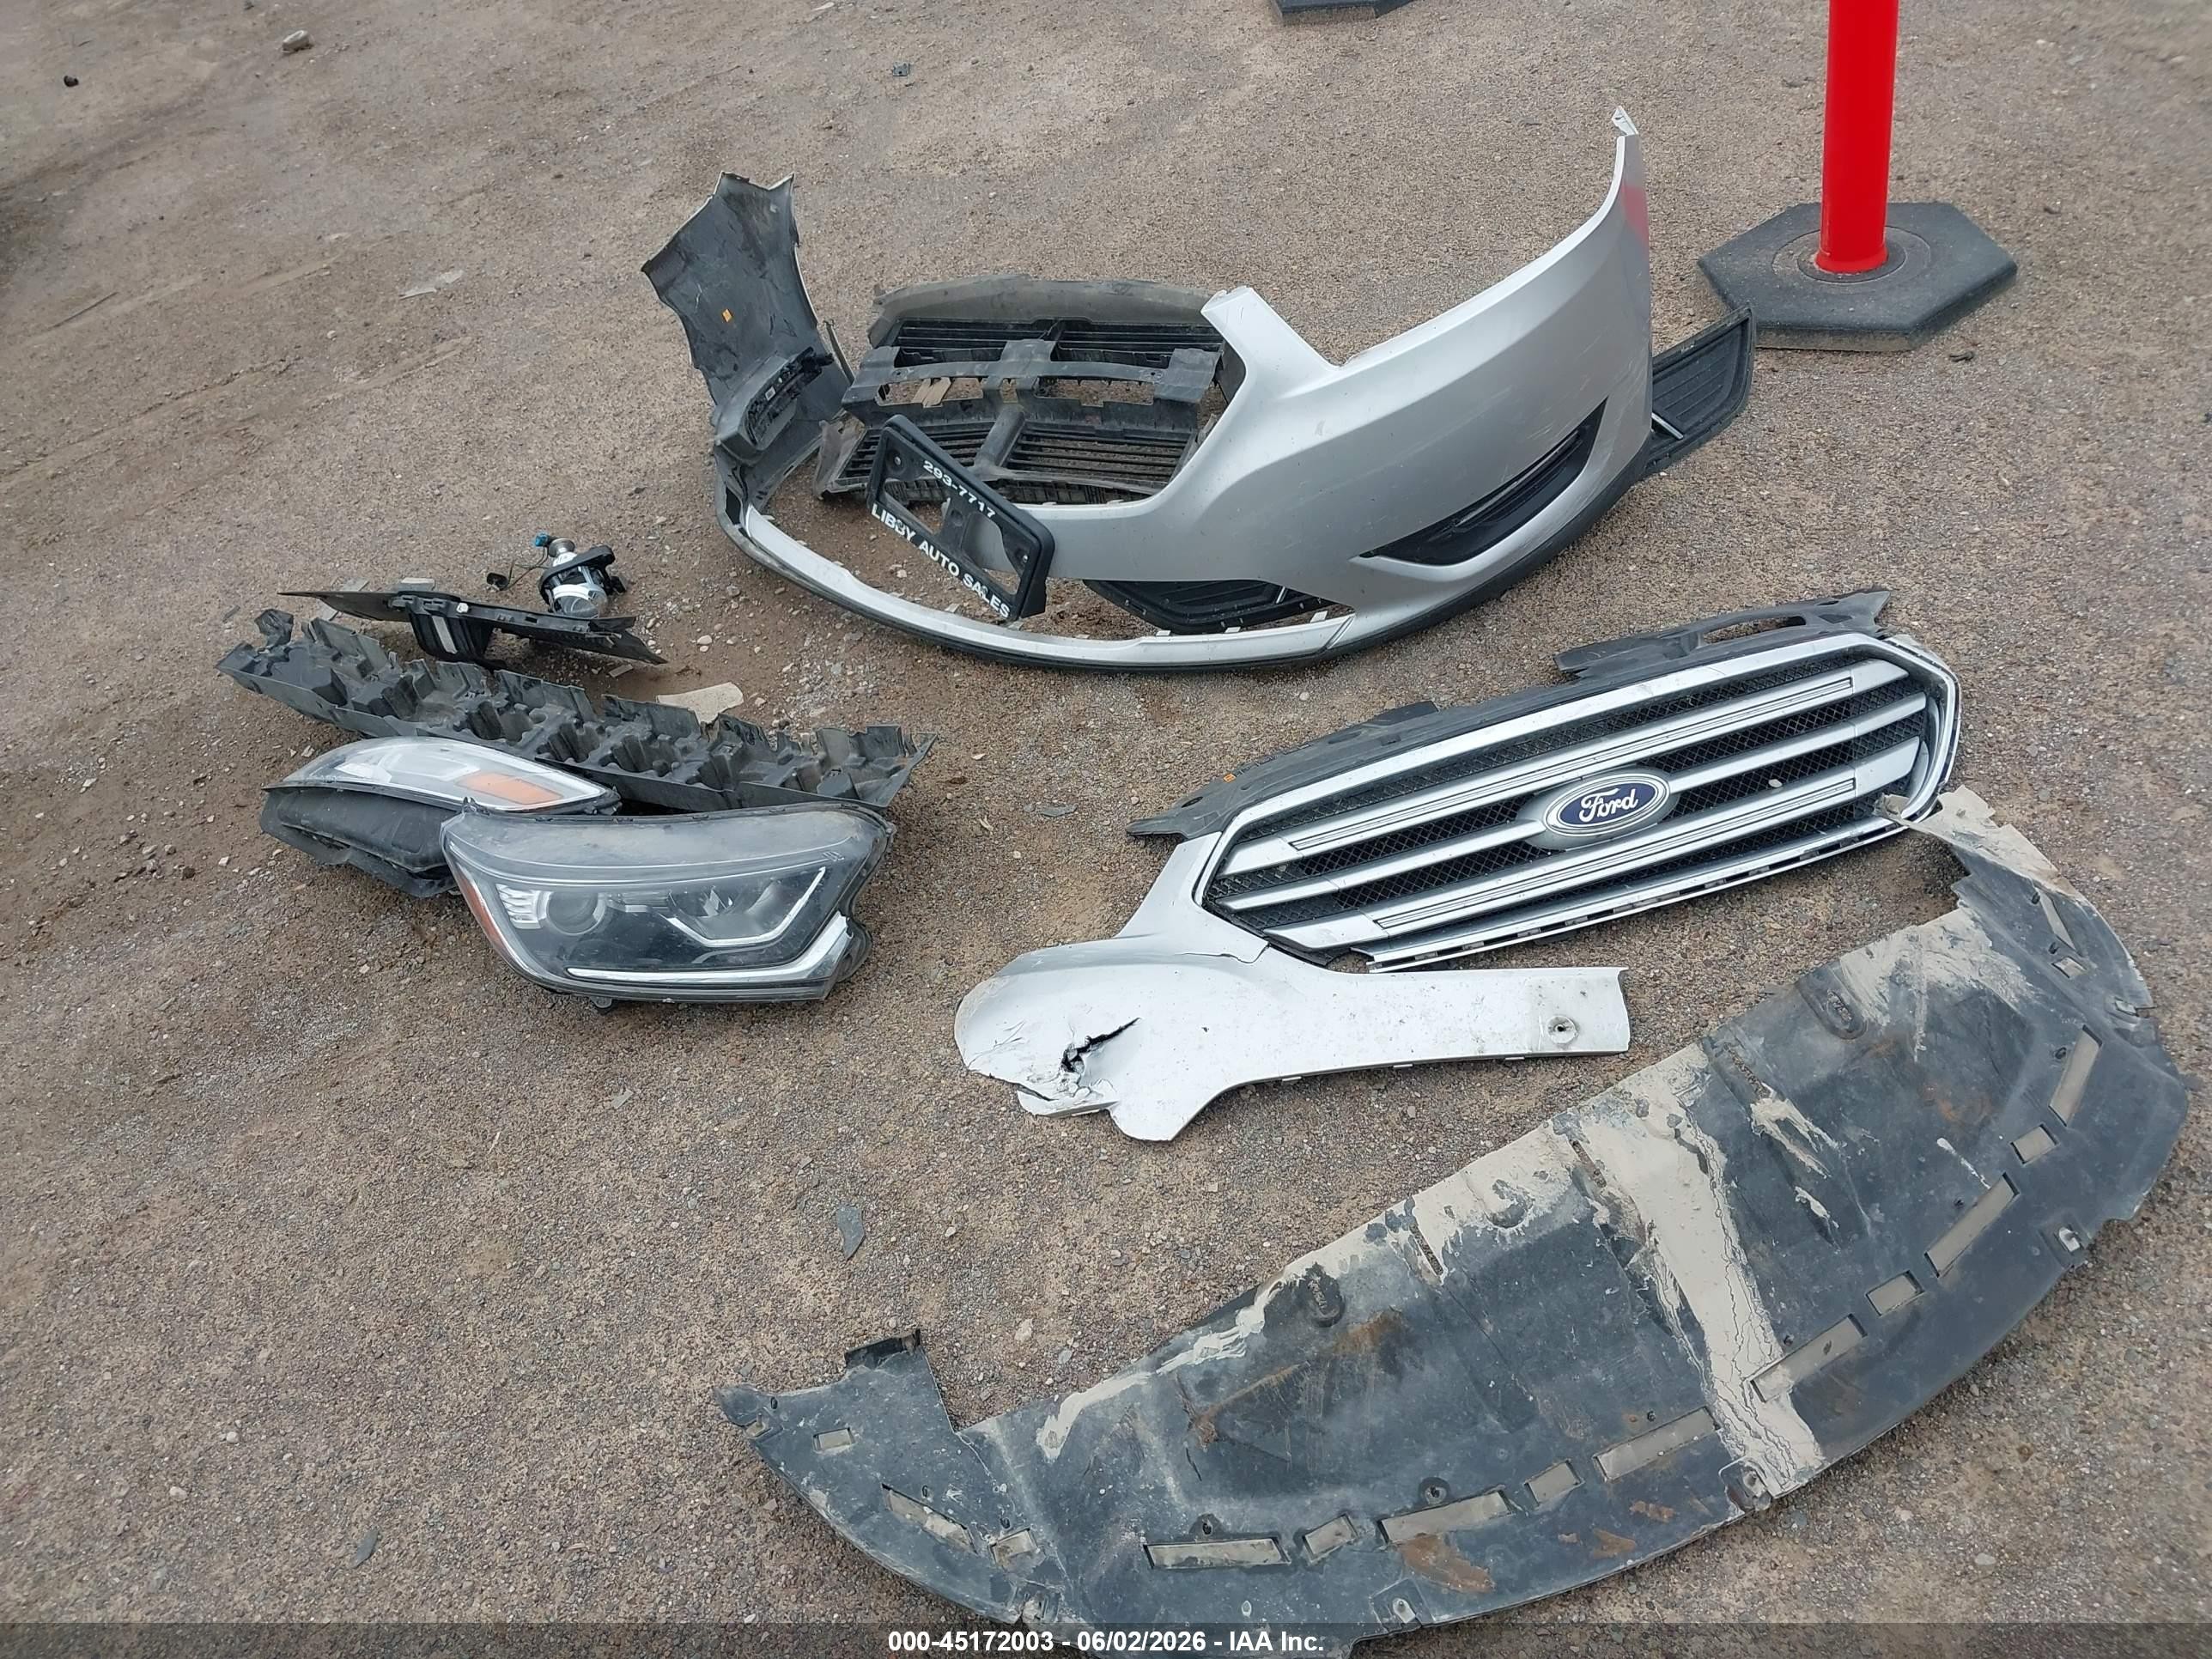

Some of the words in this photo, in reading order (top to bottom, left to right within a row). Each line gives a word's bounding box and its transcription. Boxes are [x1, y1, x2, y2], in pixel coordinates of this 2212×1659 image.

[923, 460, 996, 518] 293-7717
[871, 503, 915, 543] LIBBY
[919, 540, 960, 575] AUTO
[962, 574, 1010, 619] SALES
[1579, 788, 1639, 823] Ford
